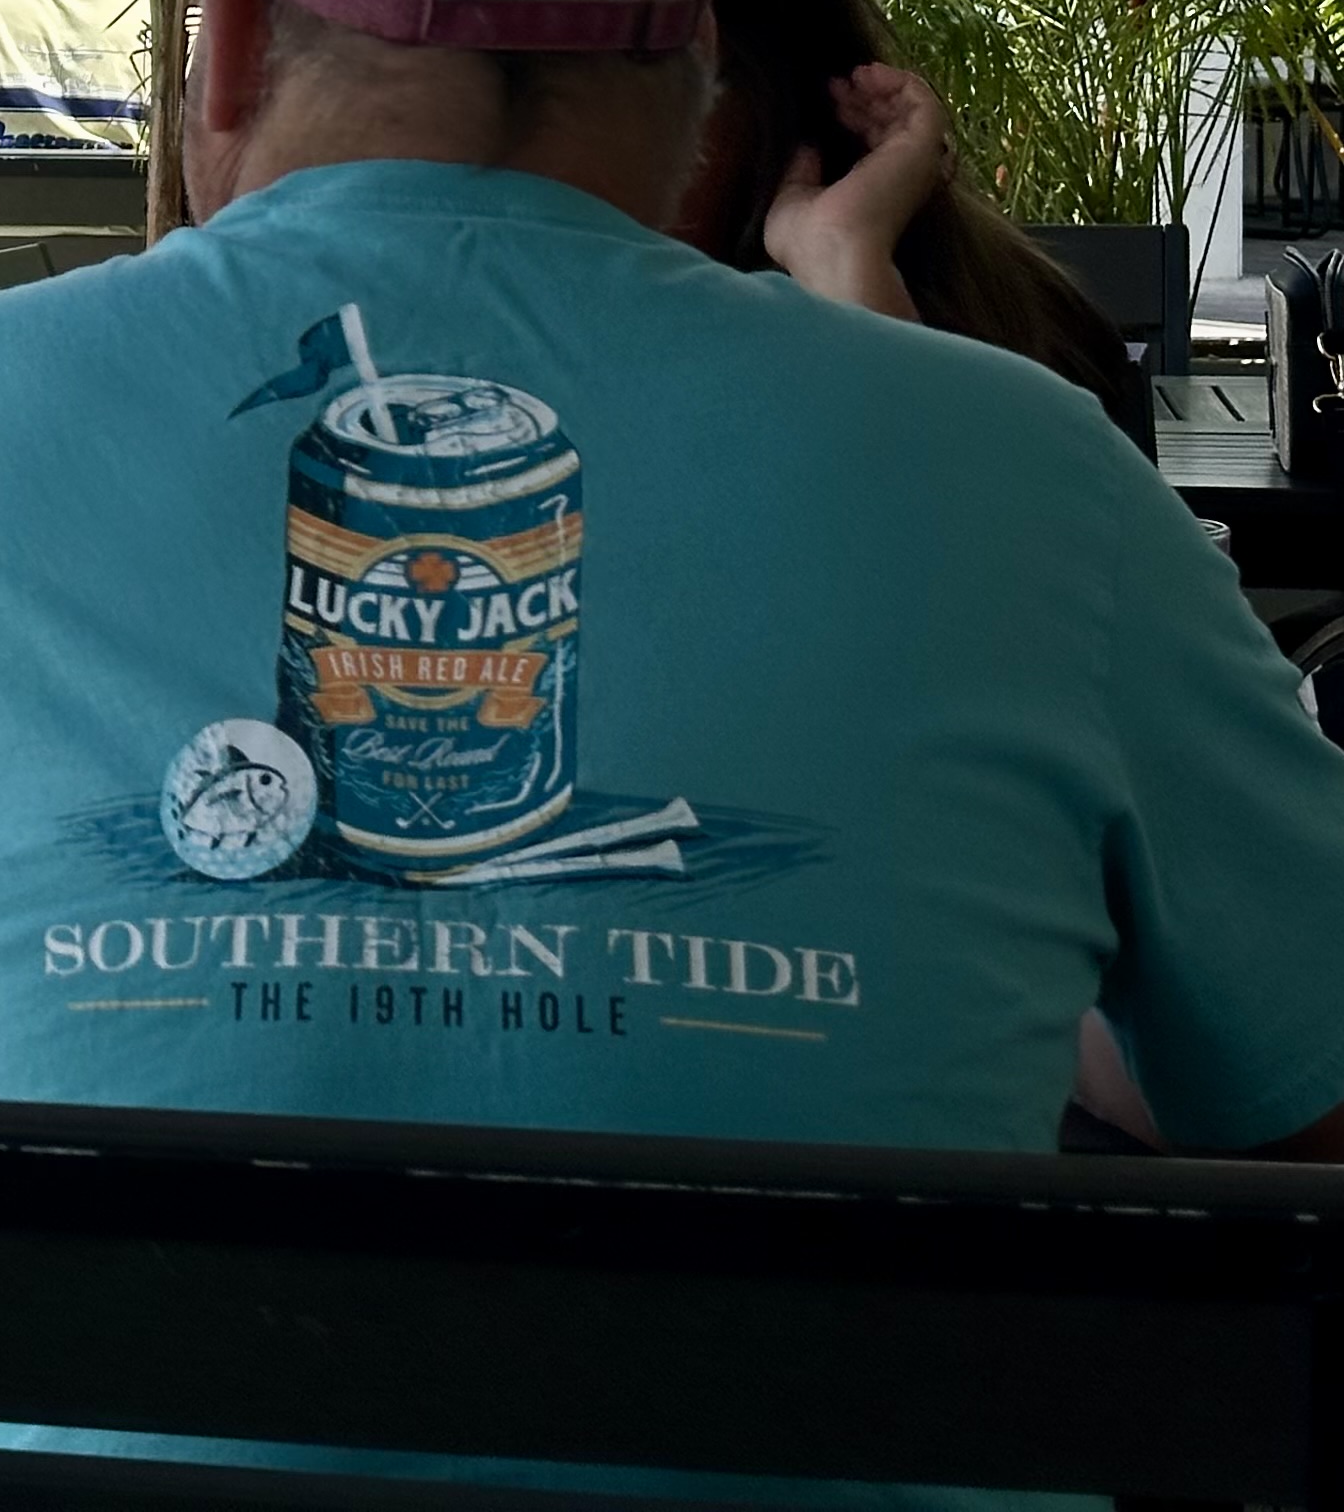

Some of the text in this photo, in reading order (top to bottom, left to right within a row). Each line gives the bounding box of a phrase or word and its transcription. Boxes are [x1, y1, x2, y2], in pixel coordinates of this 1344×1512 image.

[289, 564, 579, 643] LUCKY JACK
[328, 652, 529, 683] IRISH RED ALE
[385, 714, 470, 732] SAVE THE
[382, 770, 470, 791] FOR LAST
[44, 913, 860, 1007] SOUTHERN TIDE
[230, 981, 629, 1037] THE 19TH HOLE
